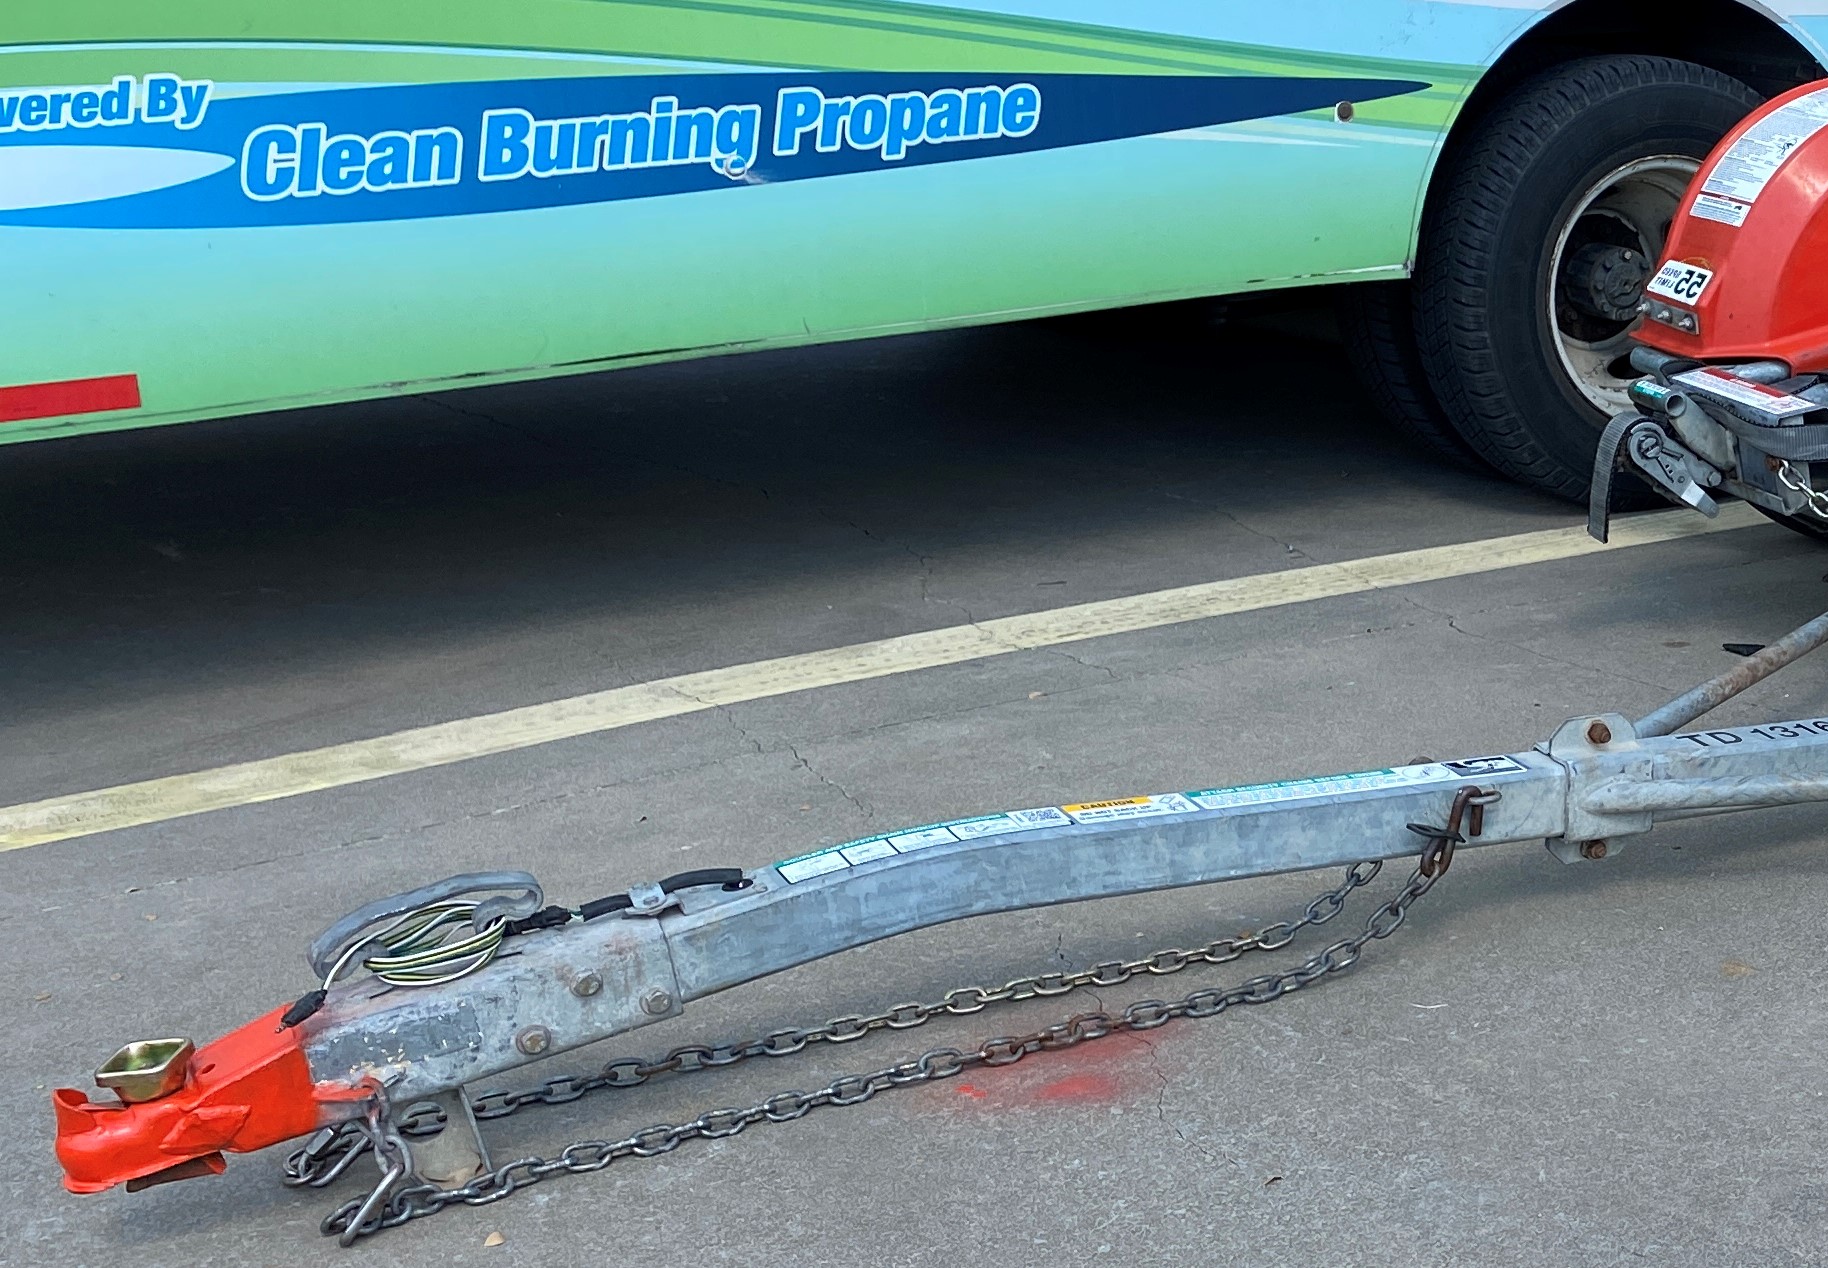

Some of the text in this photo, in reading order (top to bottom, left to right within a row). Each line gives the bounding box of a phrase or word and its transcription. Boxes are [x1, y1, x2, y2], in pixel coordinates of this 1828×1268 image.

[142, 74, 213, 130] By
[241, 84, 1040, 200] Clean Burning Propane
[1675, 731, 1743, 747] TD
[1080, 798, 1136, 810] CAUTION
